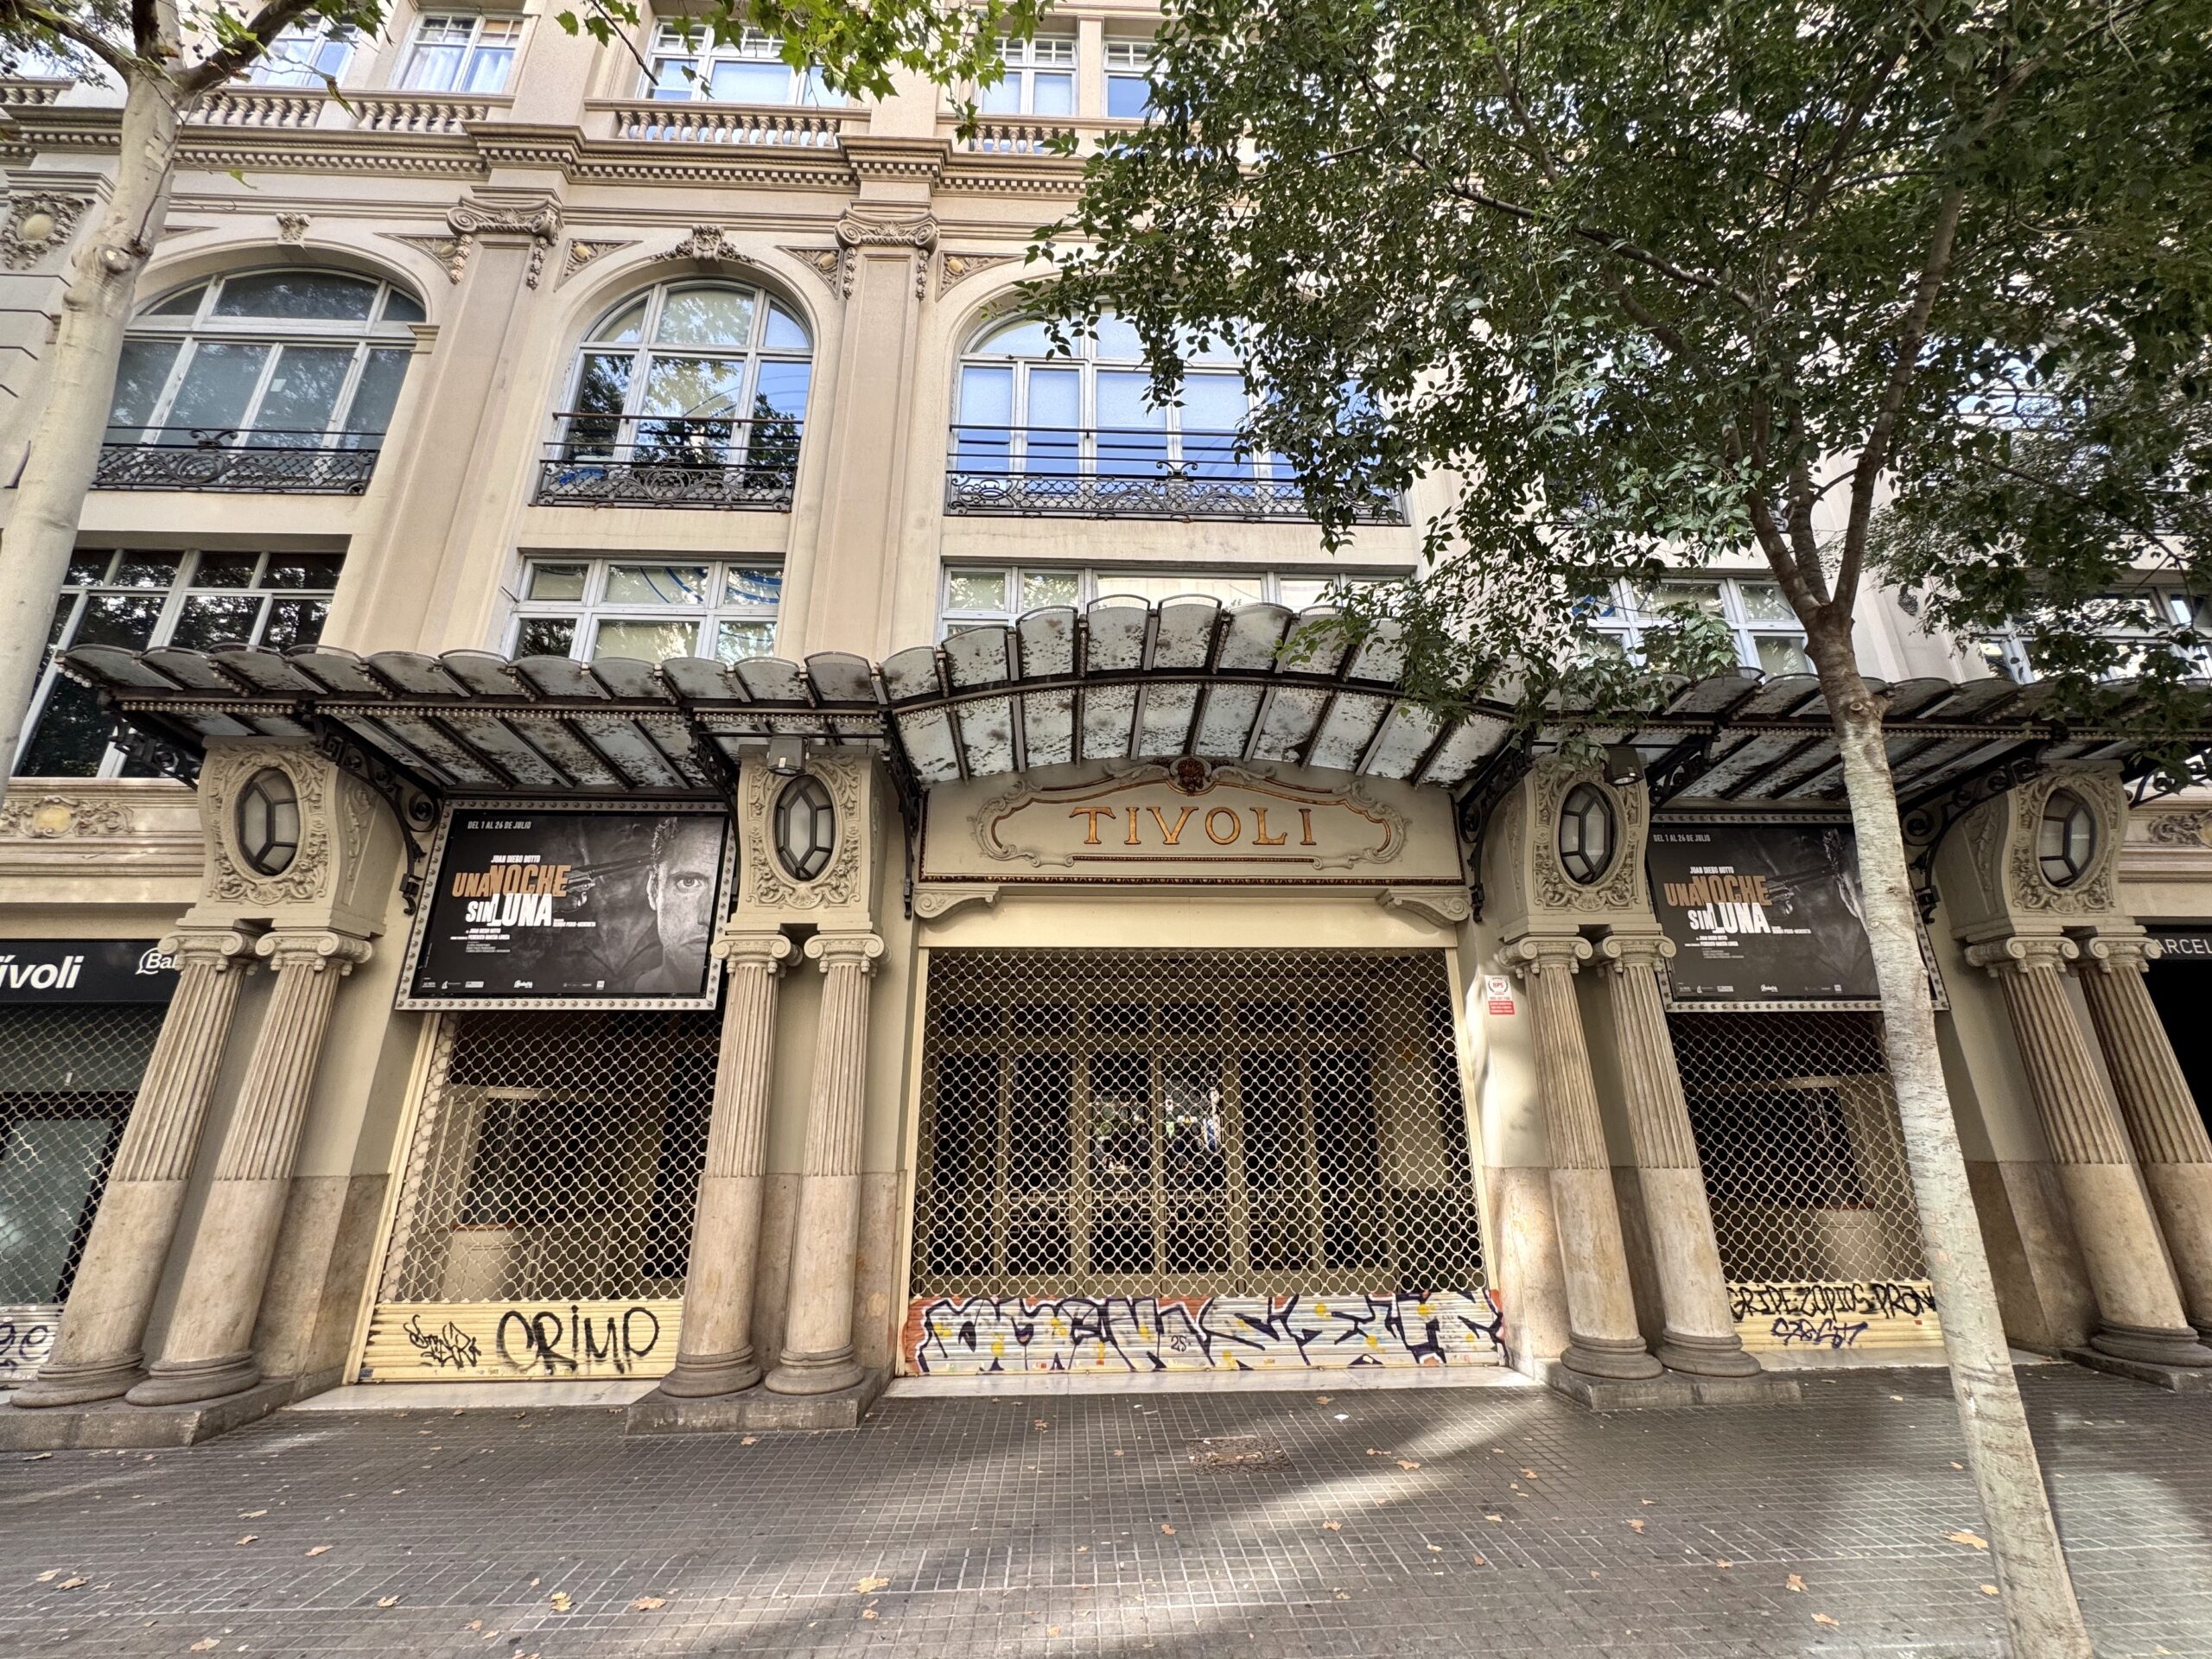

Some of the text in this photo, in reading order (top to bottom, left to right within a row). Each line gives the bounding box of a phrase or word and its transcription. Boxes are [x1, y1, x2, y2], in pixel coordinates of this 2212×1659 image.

[467, 821, 480, 830] DEL
[481, 821, 485, 830] 1
[486, 821, 493, 830] AL
[504, 821, 512, 830] DE
[513, 821, 531, 830] JULIO
[1069, 806, 1318, 846] TIVOLI
[1653, 834, 1664, 842] DEL
[1669, 834, 1677, 842] AL
[1687, 834, 1694, 842] DE
[1694, 834, 1711, 842] JULIO
[452, 864, 572, 898] UNA NOCHE
[1663, 874, 1773, 906] UNA NOCHE
[465, 893, 553, 927] SIN LUNA
[1688, 901, 1771, 934] SIN LUNA
[0, 955, 85, 988] ívoli
